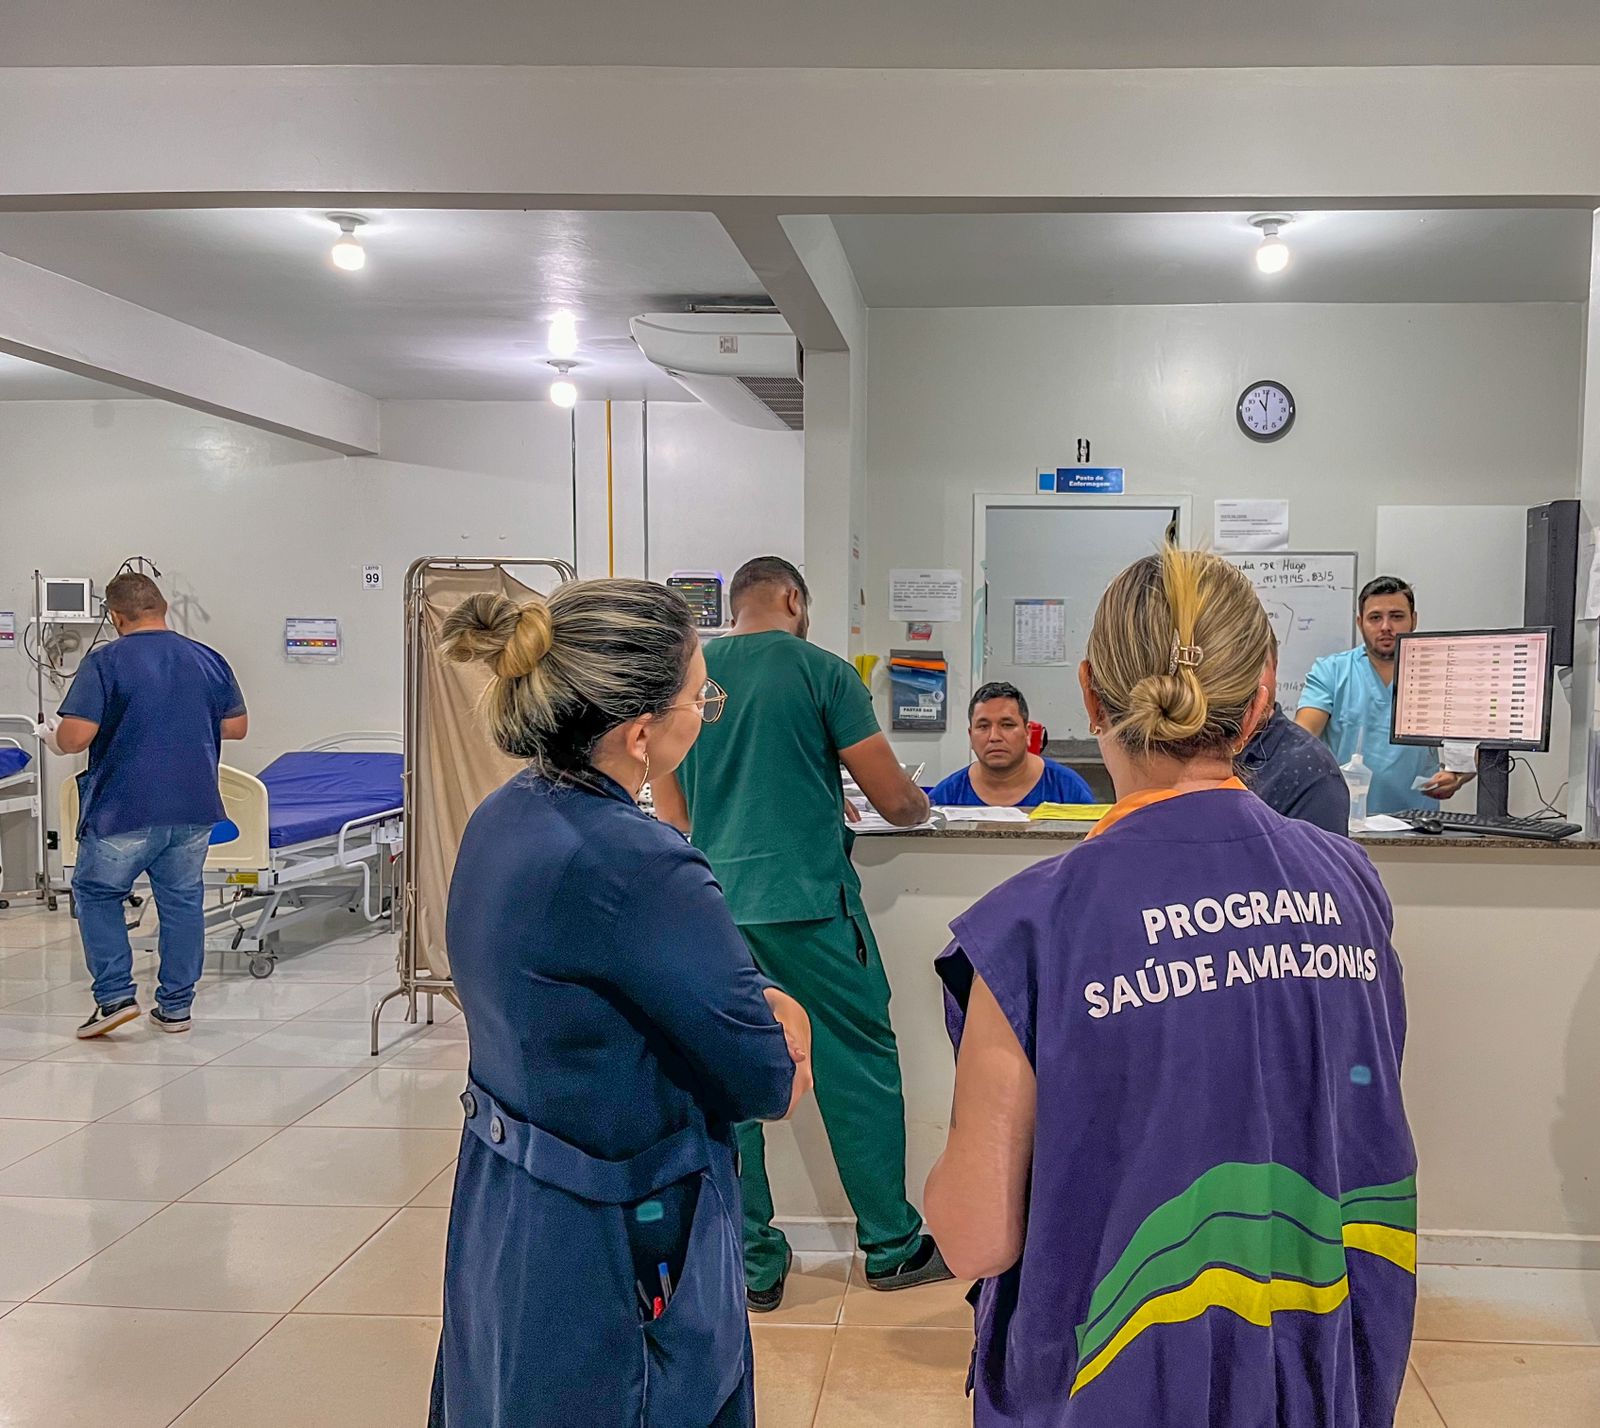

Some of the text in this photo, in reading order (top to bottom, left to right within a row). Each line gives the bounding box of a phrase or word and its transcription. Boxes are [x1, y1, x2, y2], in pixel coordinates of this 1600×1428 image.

[365, 573, 379, 583] 99
[1282, 559, 1307, 574] Hugo
[1141, 889, 1342, 945] PROGRAMA
[1083, 943, 1377, 1019] SAÚDE AMAZONAS
